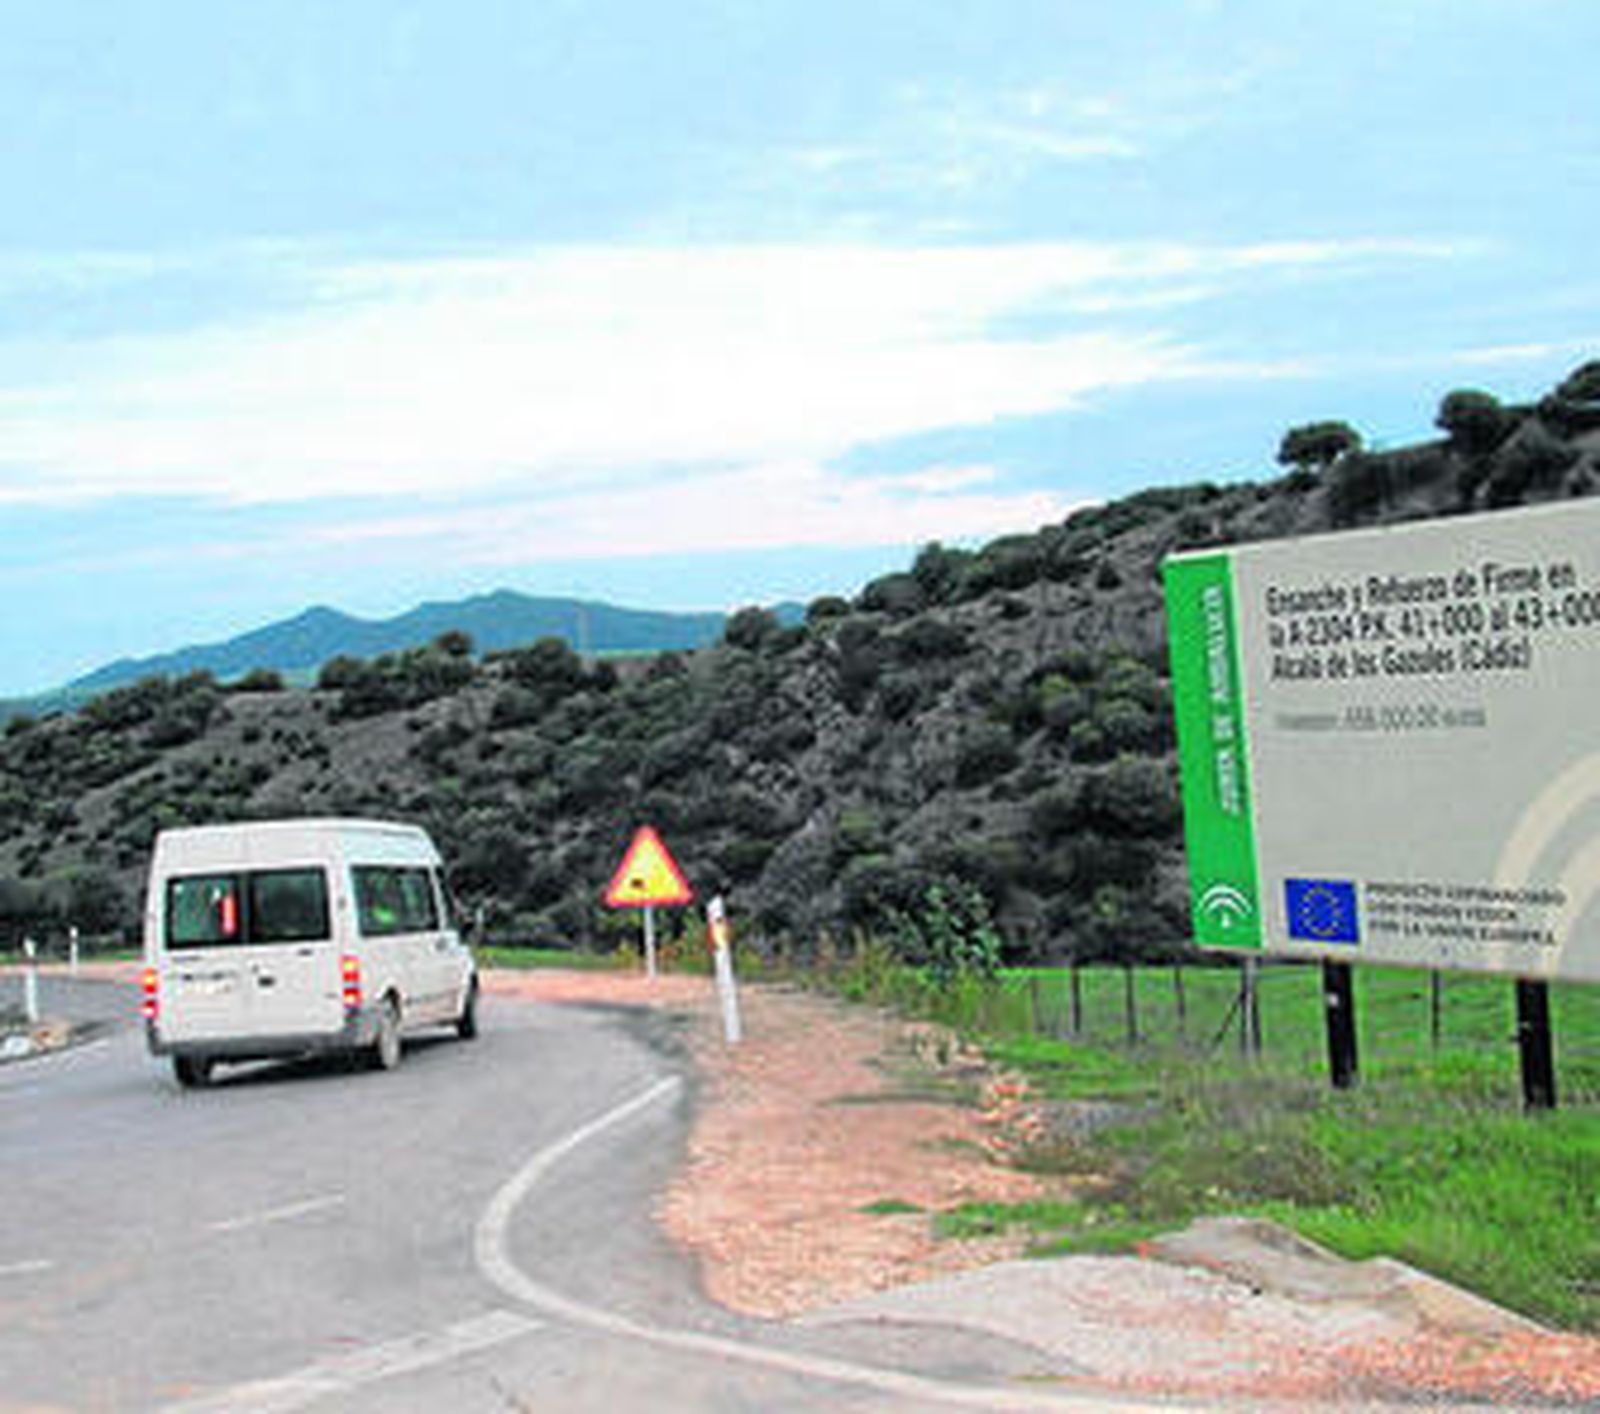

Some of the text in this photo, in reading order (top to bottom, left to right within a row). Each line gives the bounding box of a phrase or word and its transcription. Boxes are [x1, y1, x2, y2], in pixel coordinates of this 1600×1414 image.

[1266, 585, 1347, 616] Ensanche
[1368, 576, 1447, 604] Refuerzo
[1453, 568, 1478, 597] de
[1483, 562, 1541, 595] Firme
[1548, 563, 1576, 588] en
[1327, 650, 1348, 679] de
[1352, 648, 1378, 677] los
